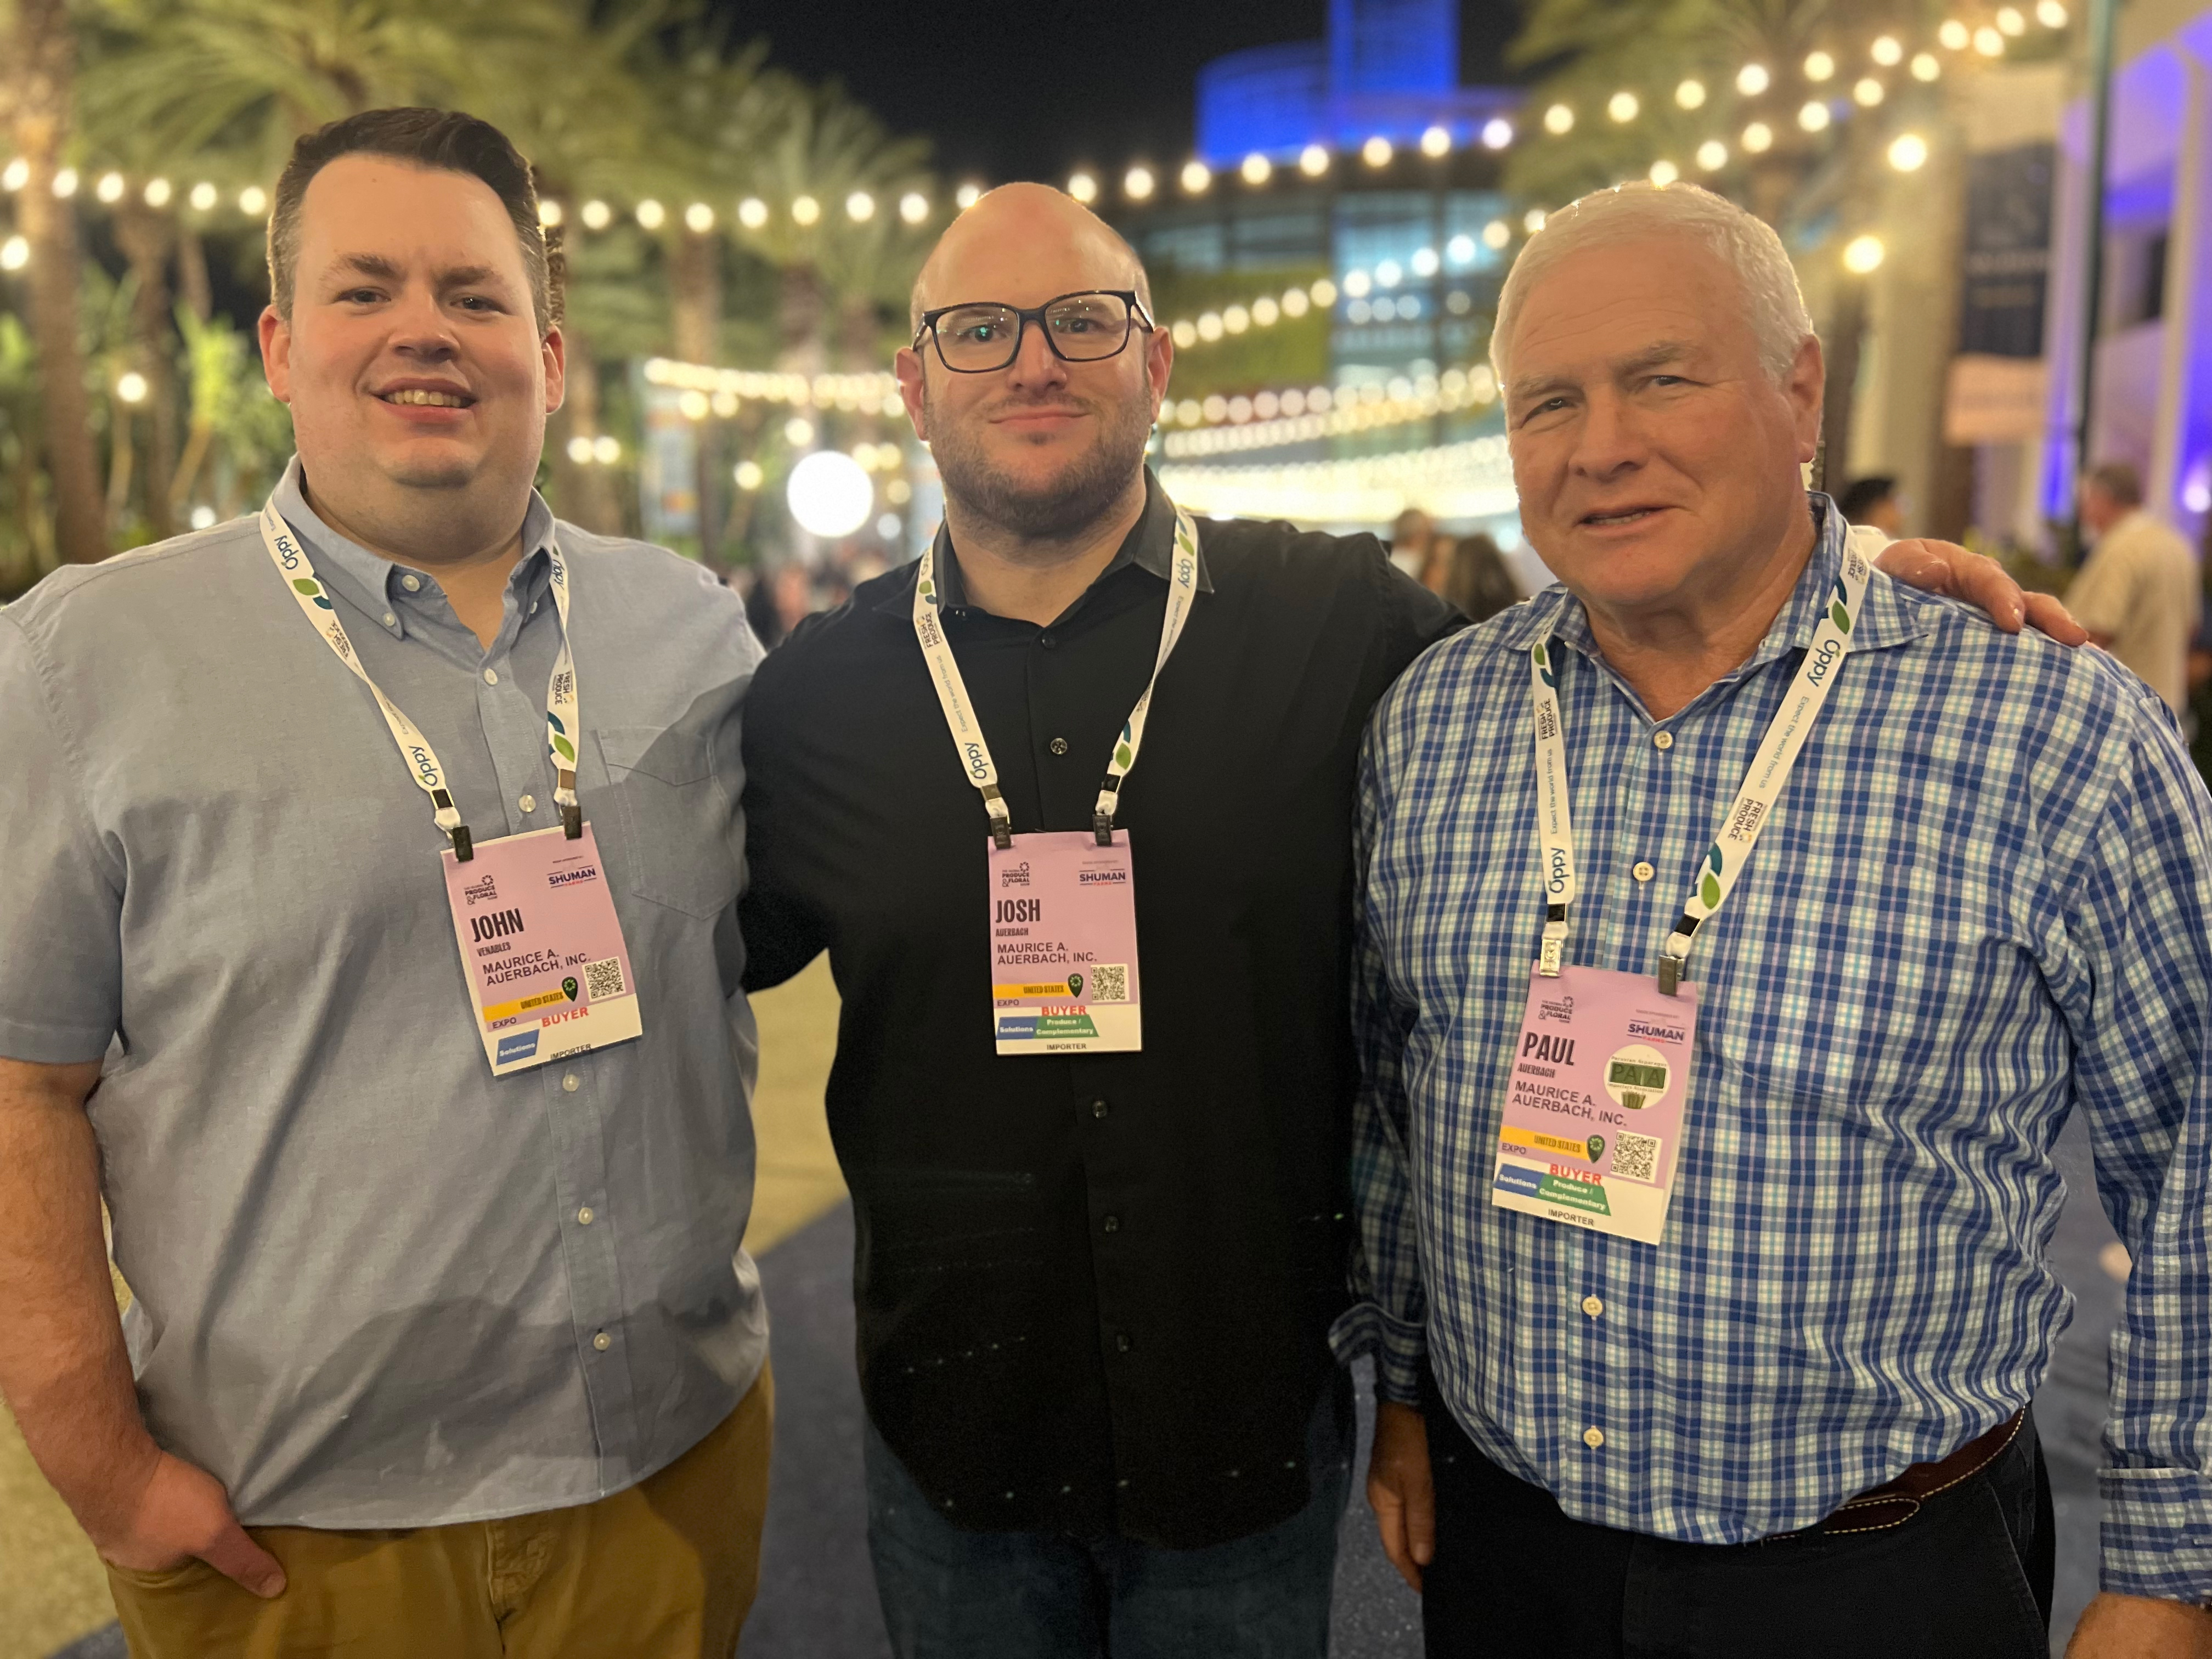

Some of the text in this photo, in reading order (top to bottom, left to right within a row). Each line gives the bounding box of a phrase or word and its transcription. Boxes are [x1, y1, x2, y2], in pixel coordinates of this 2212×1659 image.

[274, 535, 299, 570] Oppy
[1176, 558, 1193, 588] Oppy
[921, 624, 933, 648] FRESH
[936, 655, 943, 663] us
[1807, 639, 1841, 687] Oppy
[939, 664, 947, 679] from
[944, 679, 955, 697] world
[956, 710, 968, 732] Expect
[1544, 697, 1555, 737] PRODUCE
[1540, 713, 1548, 740] FRESH
[1759, 696, 1809, 789] Expect the world from us
[964, 742, 989, 779] Oppy
[1548, 748, 1553, 757] us
[408, 746, 438, 786] Oppy
[1728, 798, 1754, 840] PRODUCE
[1743, 802, 1763, 831] FRESH
[549, 868, 596, 884] SHUMAN
[1079, 872, 1125, 882] SHUMAN
[1549, 847, 1570, 893] Oppy
[1002, 878, 1009, 887] &
[995, 899, 1040, 923] JOSH
[470, 908, 524, 943] JOHN
[996, 927, 1029, 937] AUERBACH
[477, 941, 511, 957] VENABLES
[997, 942, 1069, 953] MAURICE A.
[483, 949, 560, 974] MAURICE A.
[997, 952, 1097, 965] AUERBACH, INC.
[487, 953, 591, 986] AUERBACH, INC.
[1023, 986, 1043, 994] UNITED
[521, 992, 564, 1009] UNITED STATES
[1541, 1003, 1572, 1014] PRODUCE
[541, 1007, 589, 1028] BUYER
[1041, 1005, 1087, 1017] BUYER
[492, 1017, 517, 1029] EXPO
[1036, 1028, 1093, 1036] Complementary
[1628, 1023, 1684, 1041] SHUMAN
[499, 1043, 536, 1057] Solutions
[550, 1043, 591, 1059] IMPORTER
[1522, 1031, 1575, 1066] PAUL
[1517, 1063, 1555, 1079] AUERBACH
[1515, 1080, 1596, 1106] MAURICE A.
[1512, 1093, 1627, 1126] AUERBACH, INC.
[1502, 1143, 1526, 1155] EXPO
[1534, 1135, 1581, 1153] UNITED STATES
[1499, 1174, 1537, 1189] Solutions
[1549, 1163, 1602, 1186] BUYER
[1553, 1180, 1588, 1194] Produce
[1539, 1188, 1606, 1210] Complementary
[1548, 1209, 1594, 1226] IMPORTER
